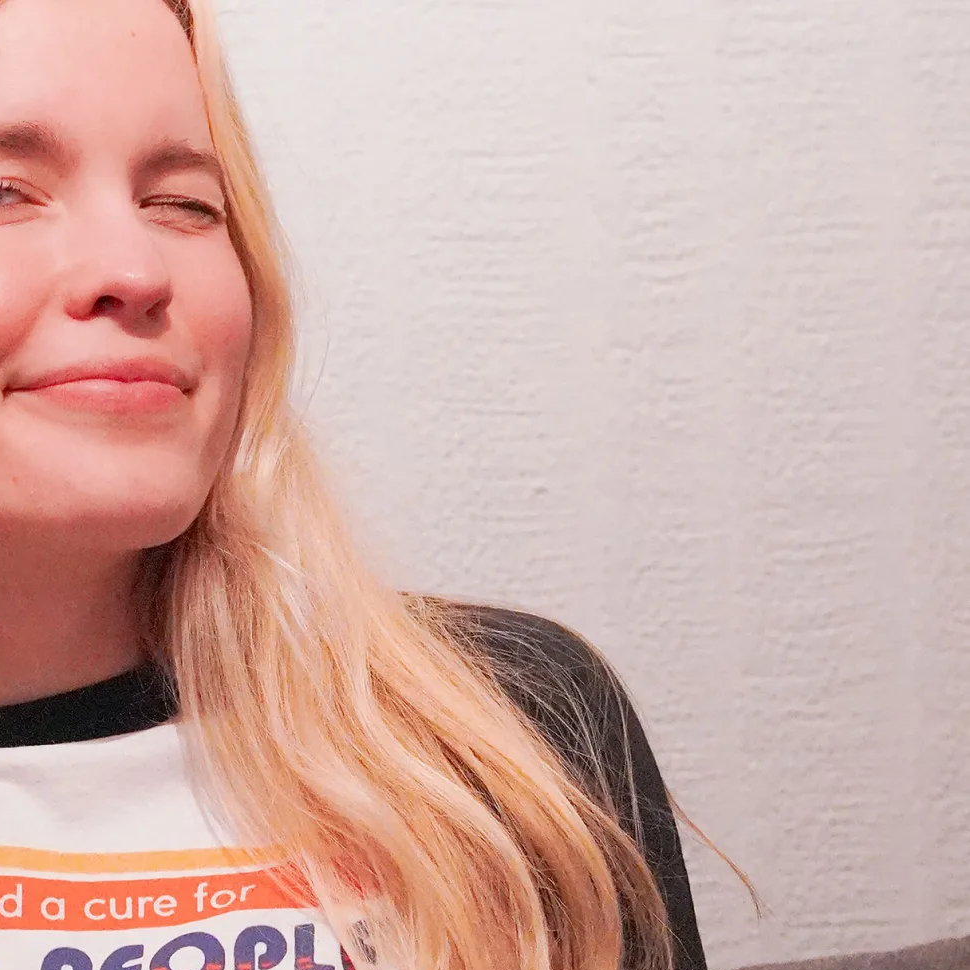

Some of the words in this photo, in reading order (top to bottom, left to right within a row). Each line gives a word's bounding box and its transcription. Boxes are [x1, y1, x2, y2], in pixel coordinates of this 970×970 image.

[40, 897, 66, 921] a
[83, 894, 178, 921] cure
[193, 882, 257, 913] for
